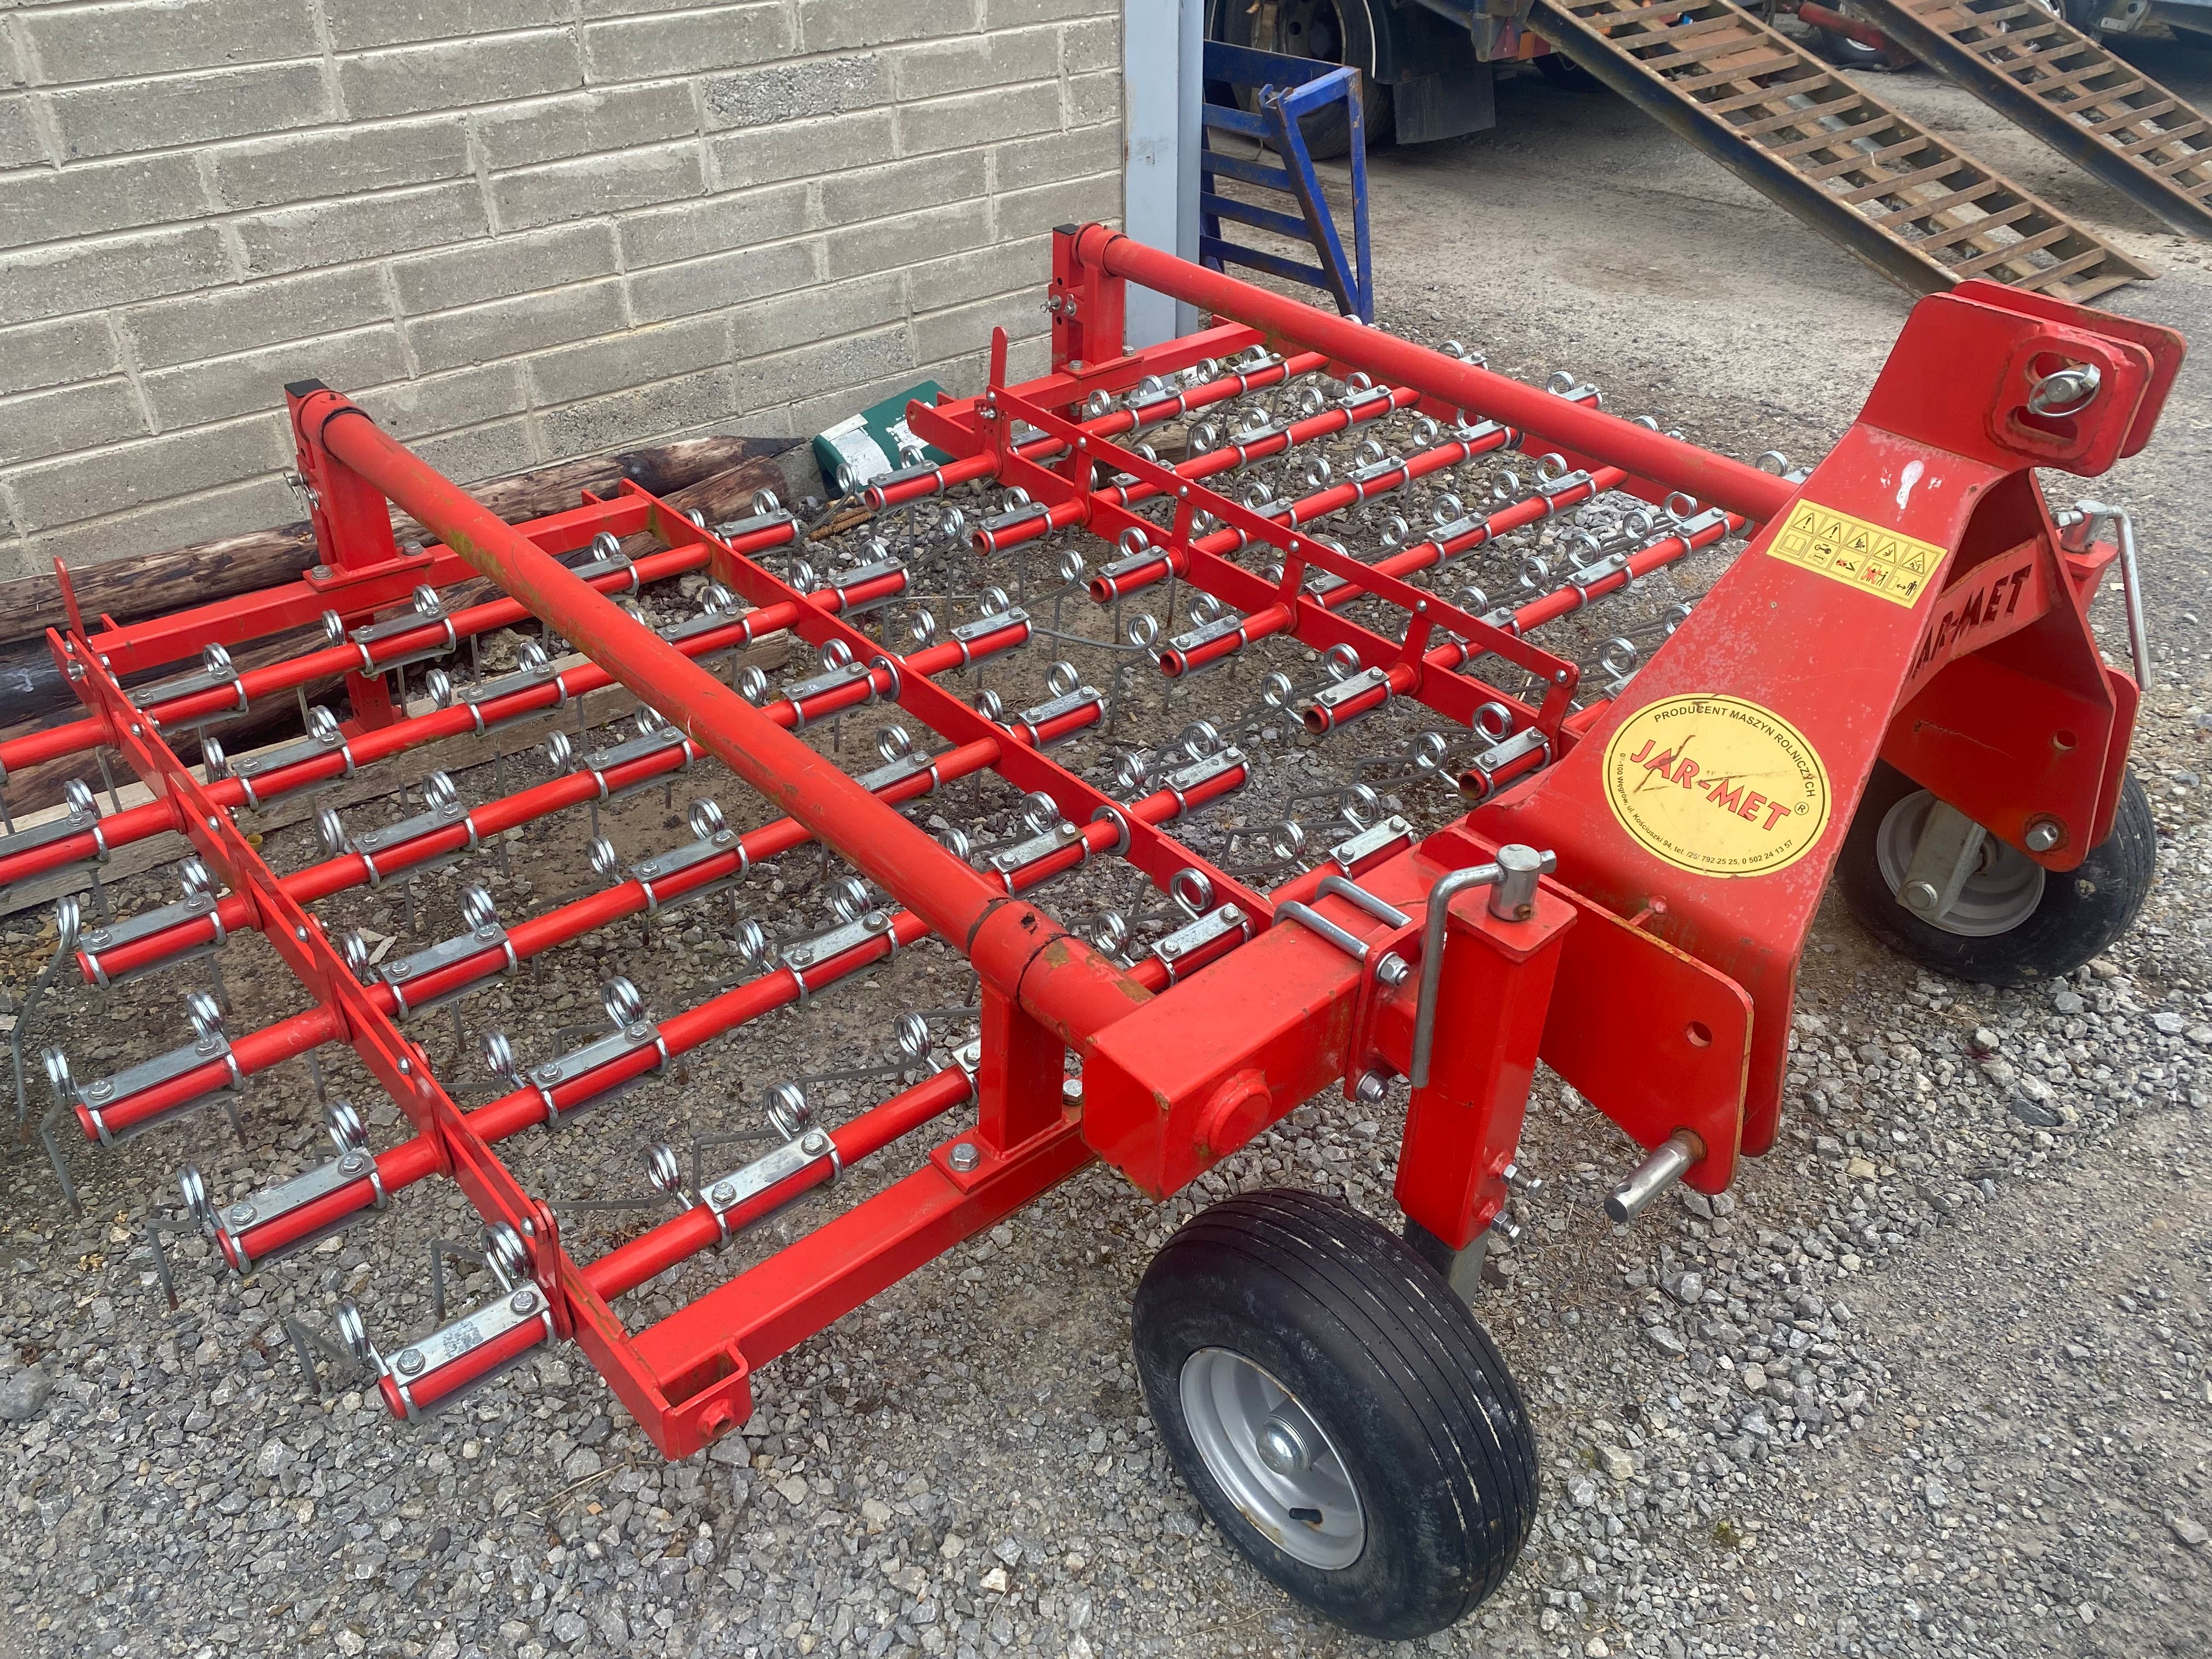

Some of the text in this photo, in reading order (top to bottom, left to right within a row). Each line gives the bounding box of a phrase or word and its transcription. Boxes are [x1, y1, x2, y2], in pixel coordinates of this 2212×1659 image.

[1908, 563, 2032, 679] AR-MET
[1630, 739, 1792, 831] JAR-MET
[1654, 706, 1816, 797] PRODUCENT MASZYN ROLNICZYCH
[1633, 813, 1663, 843] Kościuszki
[1663, 840, 1672, 850] 94,
[1674, 846, 1684, 855] tel.
[1701, 855, 1715, 864] 792
[1749, 855, 1763, 863] 502
[1764, 851, 1774, 860] 24
[1775, 846, 1784, 854] 13
[1784, 839, 1793, 848] 57
